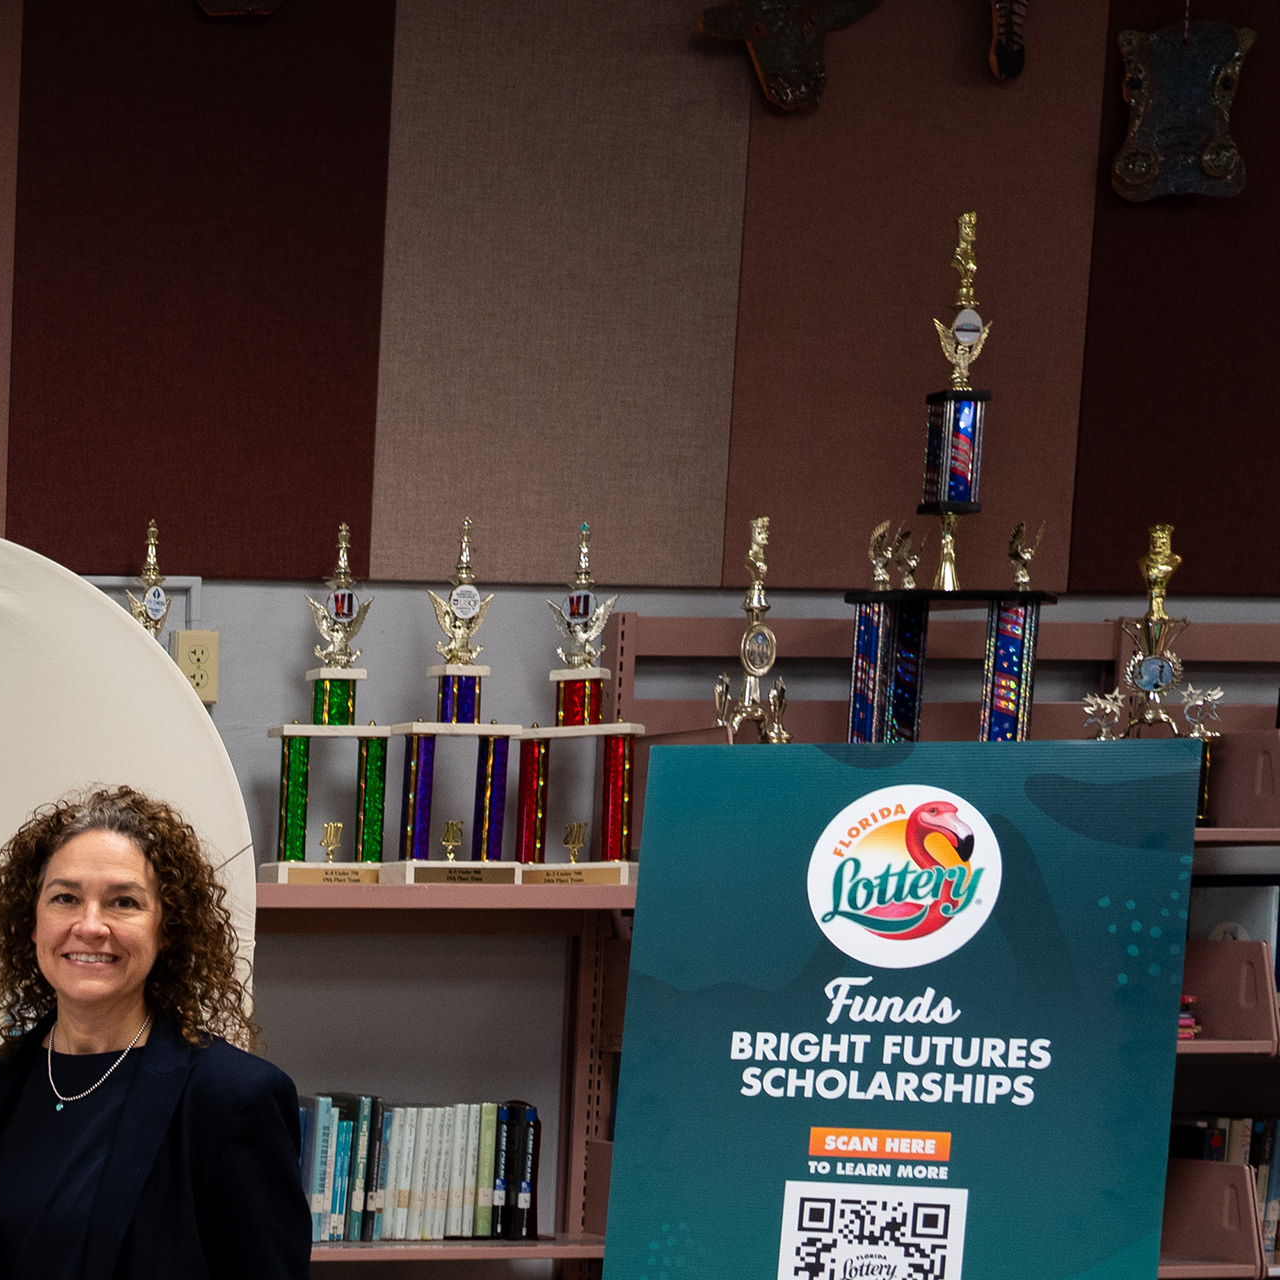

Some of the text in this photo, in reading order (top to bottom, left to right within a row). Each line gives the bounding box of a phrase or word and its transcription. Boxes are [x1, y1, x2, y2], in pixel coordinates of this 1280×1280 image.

[832, 803, 906, 858] FLORIDA
[820, 857, 986, 933] Lottery
[824, 976, 961, 1024] Funds
[731, 1032, 1051, 1069] BRIGHT FUTURES
[740, 1067, 1034, 1105] SCHOLARSHIPS
[825, 1136, 936, 1154] SCAN HERE
[808, 1161, 948, 1179] TO LEARN MORE
